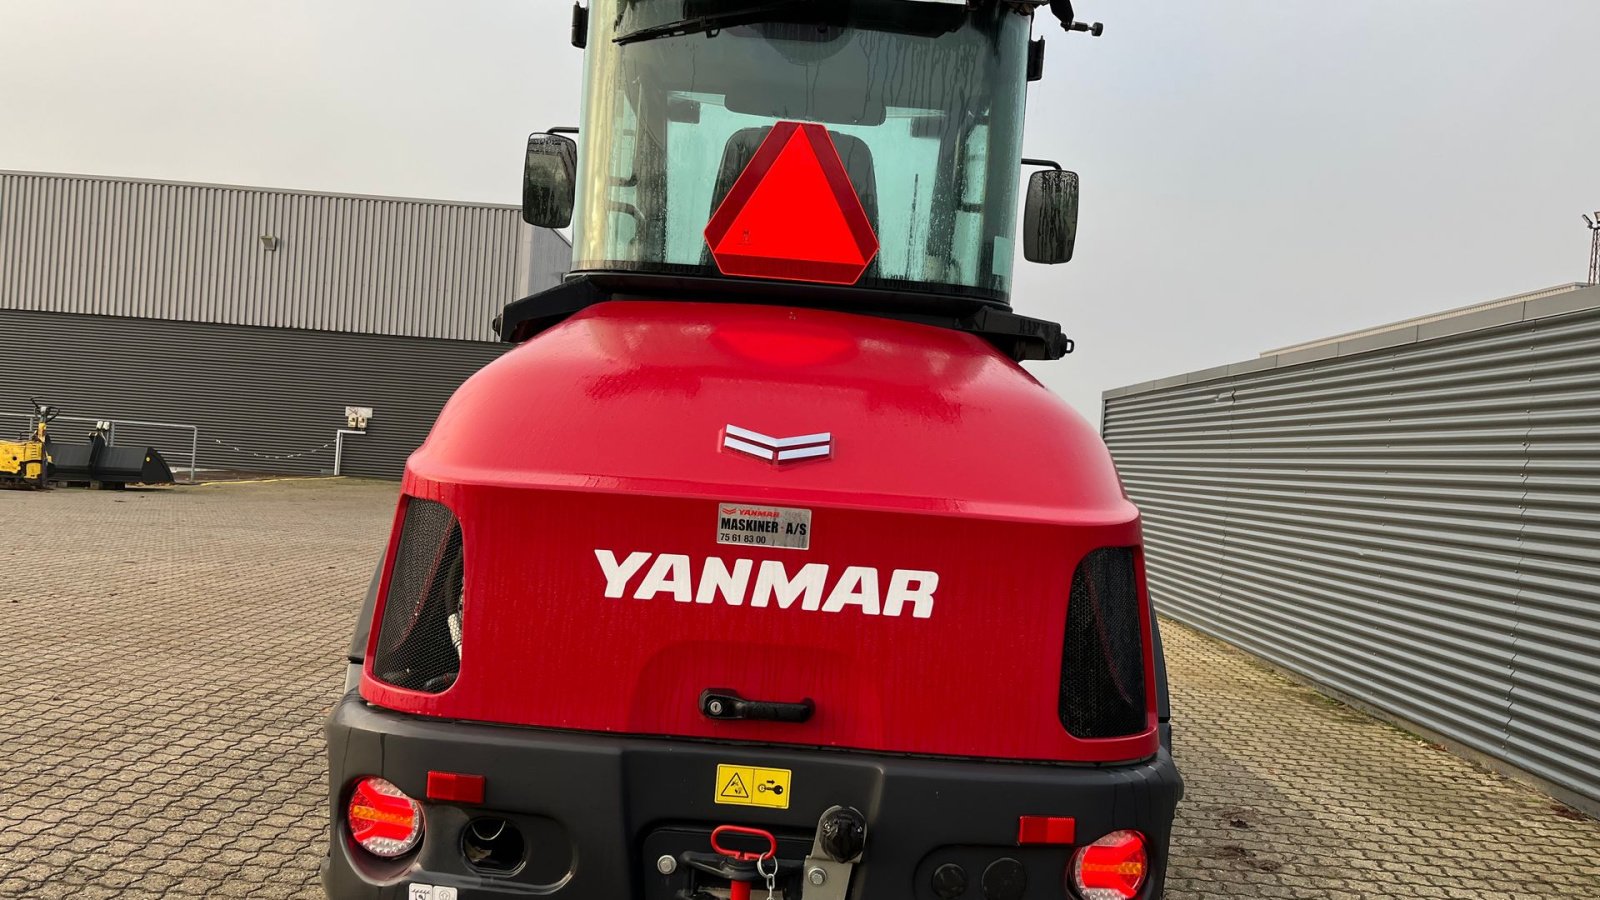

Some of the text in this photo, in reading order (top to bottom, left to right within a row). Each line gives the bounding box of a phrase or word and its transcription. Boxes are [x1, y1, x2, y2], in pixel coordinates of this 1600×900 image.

[739, 509, 780, 518] YANMAR
[721, 518, 807, 536] MASKINER A/S
[720, 533, 766, 544] 75 61 83 00
[594, 549, 939, 618] YANMAR
